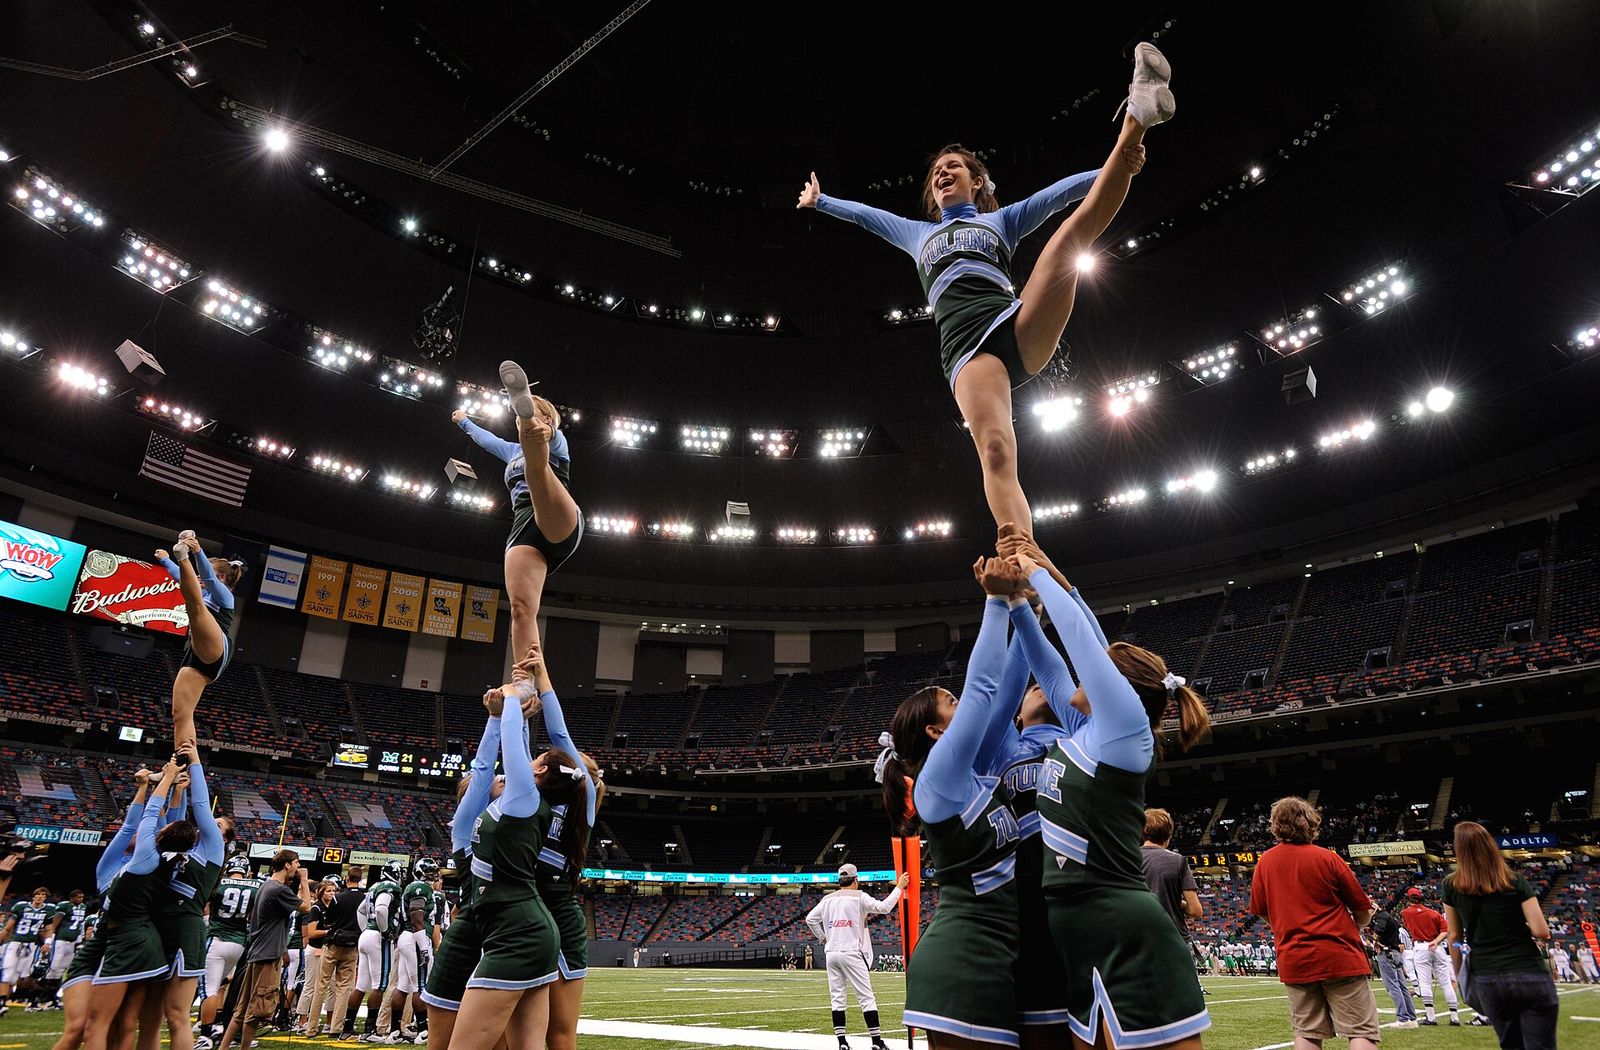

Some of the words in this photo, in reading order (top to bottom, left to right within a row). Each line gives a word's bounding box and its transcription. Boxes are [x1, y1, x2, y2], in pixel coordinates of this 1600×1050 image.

[921, 227, 999, 276] TULANE
[5, 541, 63, 570] WOW
[317, 572, 337, 583] 1991
[355, 580, 378, 591] 2000
[72, 577, 180, 614] Budweis
[393, 587, 418, 598] 2006
[431, 587, 459, 599] 2006
[306, 604, 334, 615] SAINTS
[133, 611, 167, 622] American
[348, 611, 374, 622] SAINTS
[429, 615, 455, 624] SEASON
[387, 618, 414, 628] SAINTS
[429, 621, 453, 630] TICKET
[401, 753, 413, 763] 21
[378, 764, 400, 772] DOWN
[16, 827, 61, 841] PEOPLES
[63, 831, 100, 844] HEALTH
[1512, 836, 1550, 846] DELTA
[325, 849, 340, 862] 25
[1203, 857, 1209, 866] 3
[1217, 856, 1226, 865] 12
[218, 887, 252, 919] 91
[16, 918, 45, 936] 84
[832, 919, 854, 928] USA
